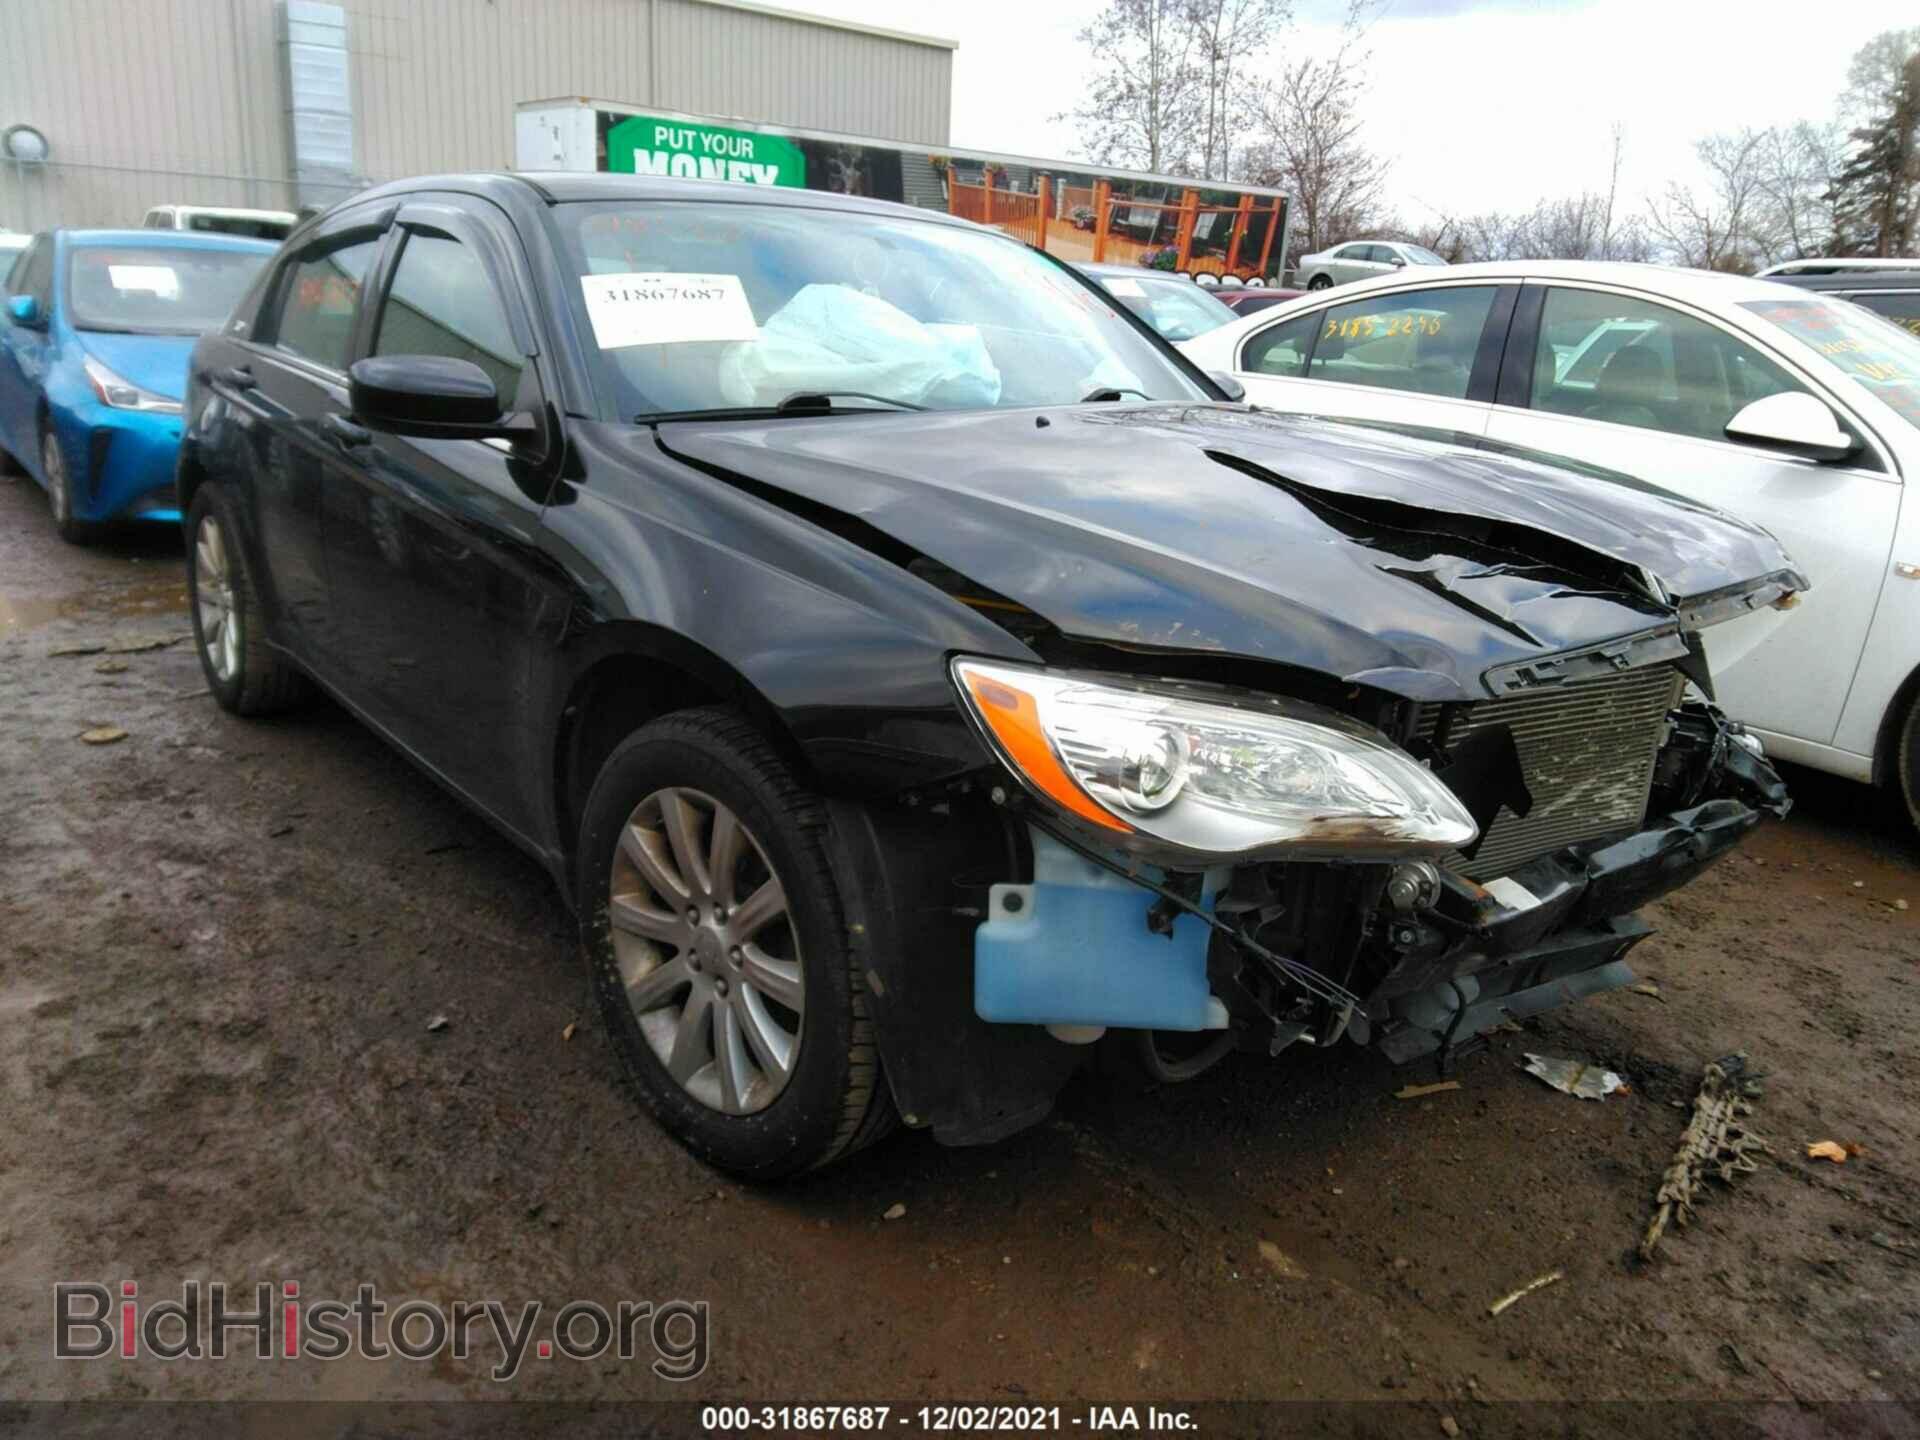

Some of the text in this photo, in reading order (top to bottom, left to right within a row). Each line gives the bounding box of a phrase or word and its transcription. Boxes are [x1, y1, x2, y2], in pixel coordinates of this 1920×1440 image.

[654, 125, 754, 159] PUT YOUR
[633, 148, 780, 186] MONEY
[604, 287, 725, 304] 31867687
